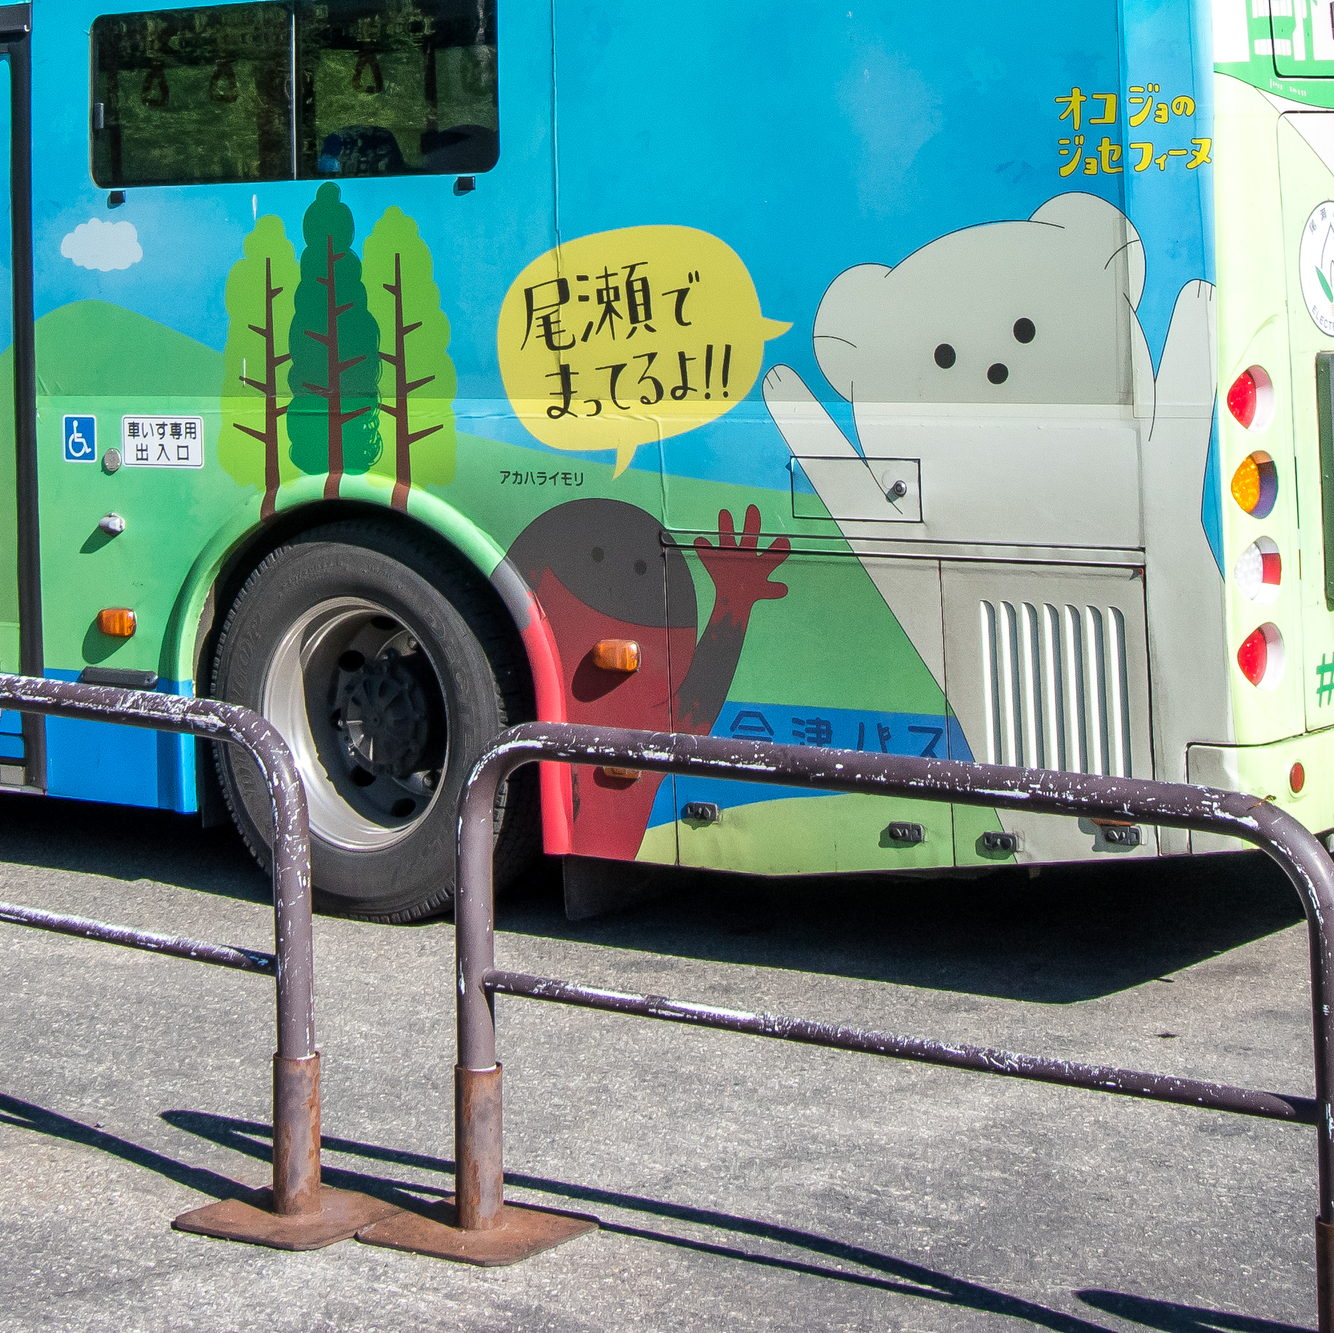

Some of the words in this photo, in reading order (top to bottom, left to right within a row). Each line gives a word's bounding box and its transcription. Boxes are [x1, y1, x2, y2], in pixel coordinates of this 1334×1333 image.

[1055, 83, 1195, 131] オコジョの
[1058, 134, 1212, 177] ジョセフィーヌ
[521, 261, 700, 351] 尾瀬で
[545, 344, 732, 420] まってるよ!!
[127, 421, 197, 440] 車いす専用
[135, 443, 190, 462] 出入口
[500, 470, 584, 486] アカハライモリ
